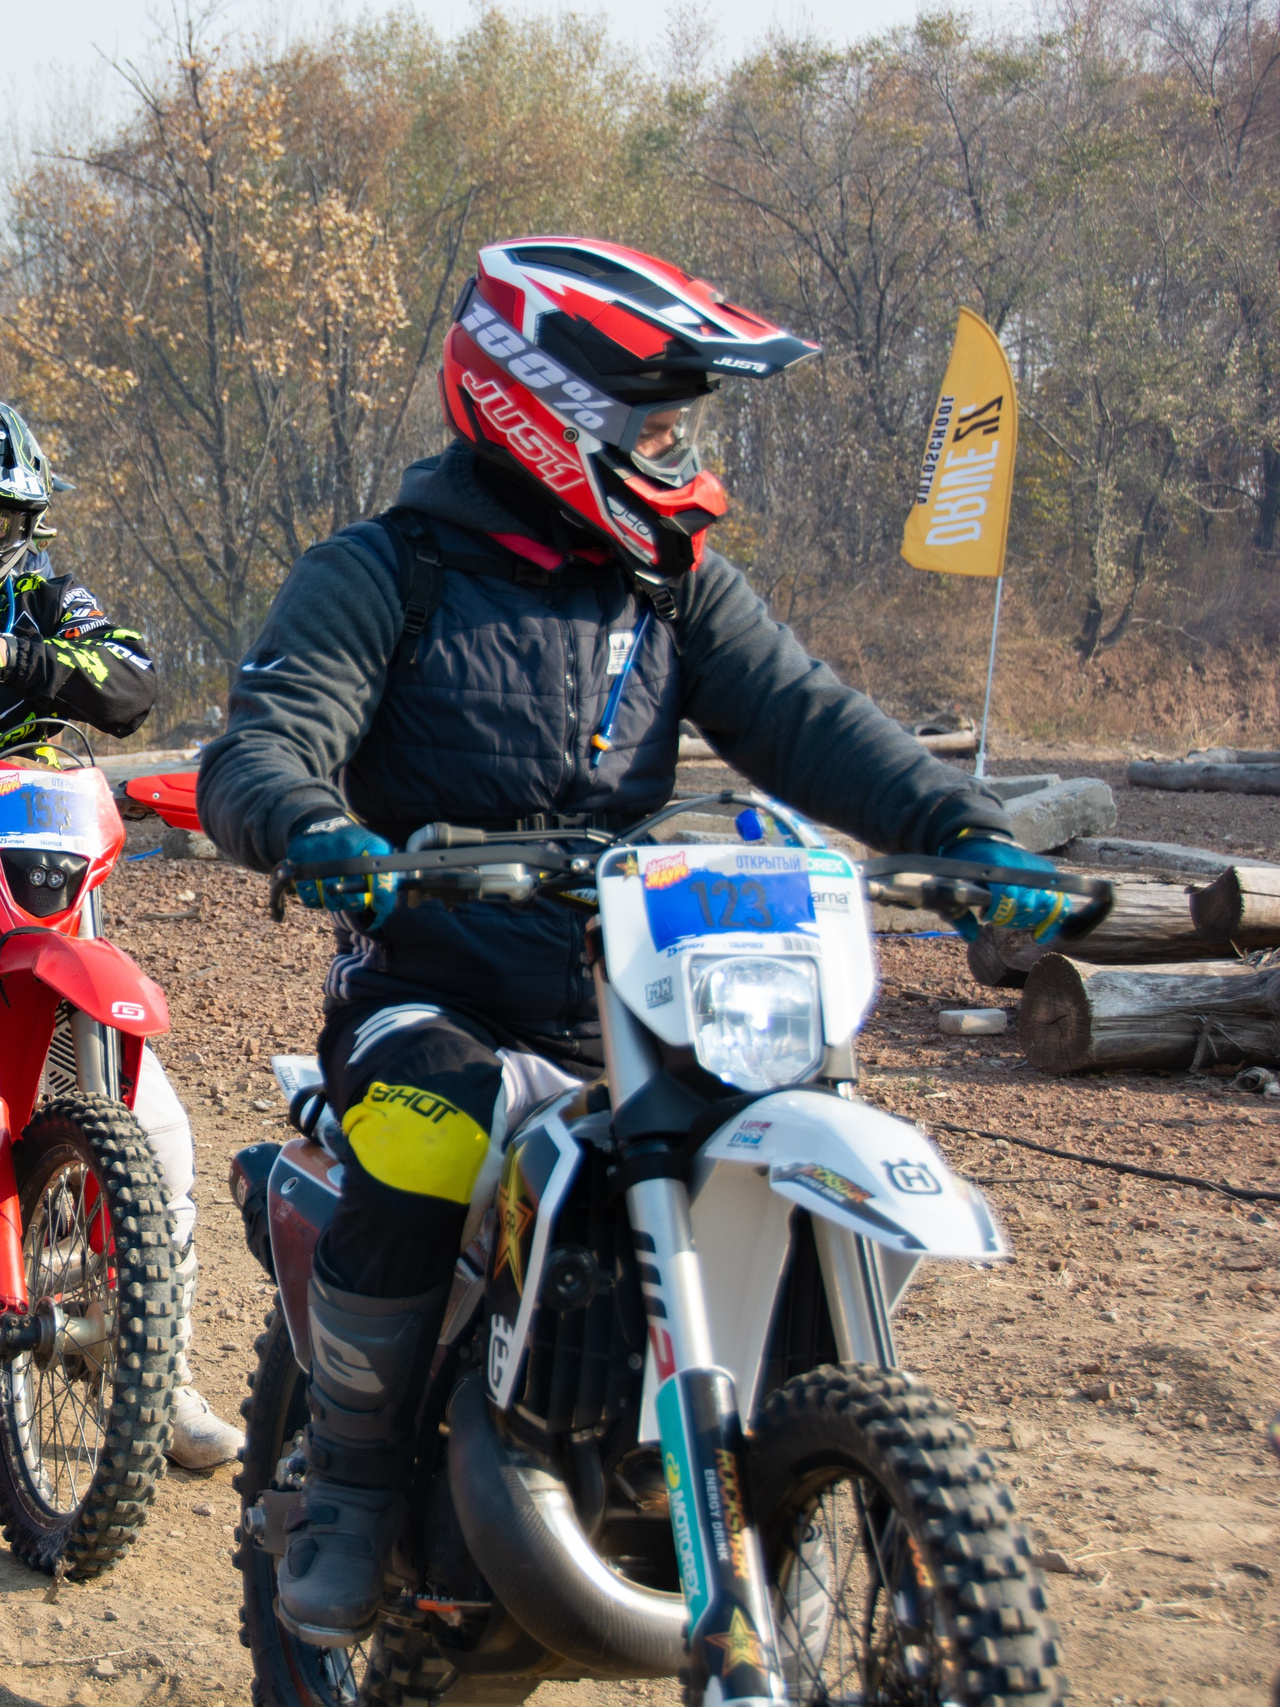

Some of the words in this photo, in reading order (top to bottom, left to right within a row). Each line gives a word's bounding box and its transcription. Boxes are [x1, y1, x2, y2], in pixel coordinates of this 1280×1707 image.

[461, 302, 613, 430] 100%
[462, 371, 584, 492] JUST1
[736, 854, 801, 871] ОТКРЫТЫЙ
[690, 880, 773, 929] 123
[371, 1085, 459, 1125] SHOT
[703, 1468, 721, 1518] ENERGY
[671, 1488, 702, 1603] MOTOREX
[711, 1520, 730, 1562] DRINK
